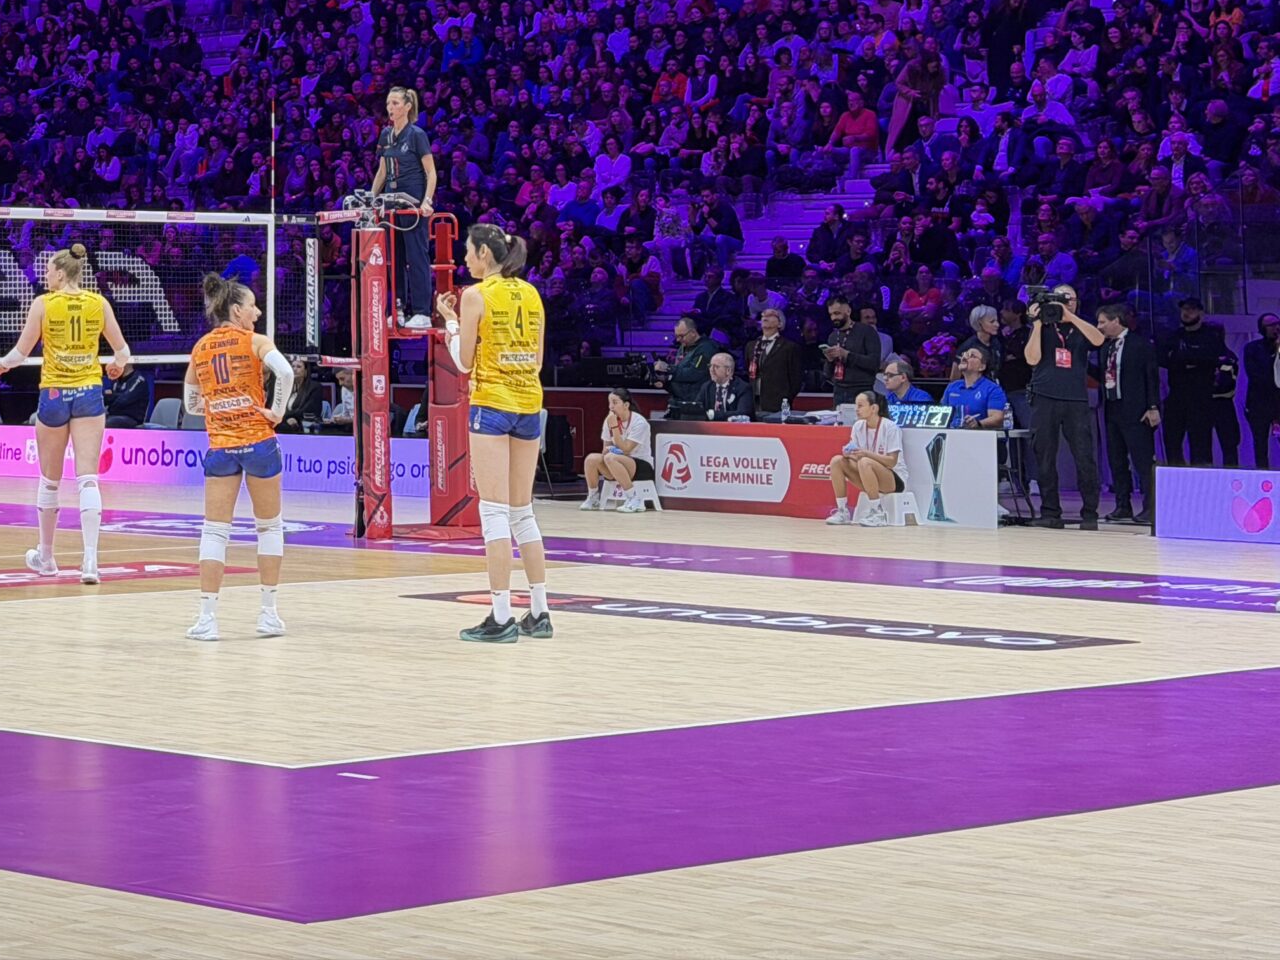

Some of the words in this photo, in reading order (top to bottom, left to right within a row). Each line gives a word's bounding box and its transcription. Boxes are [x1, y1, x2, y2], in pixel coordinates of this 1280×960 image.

[307, 239, 316, 345] FRECCIAROSSA
[70, 316, 81, 342] 11
[515, 305, 524, 337] 4
[211, 353, 230, 385] 10
[931, 412, 942, 428] 4
[122, 440, 206, 468] unobrav
[284, 455, 292, 472] Il
[295, 457, 321, 473] tuo
[374, 416, 382, 488] FRECCIAROSSA
[700, 456, 730, 469] LEGA
[733, 457, 778, 471] VOLLEY
[705, 472, 773, 486] FEMMINILE
[591, 601, 1057, 646] unobravo
